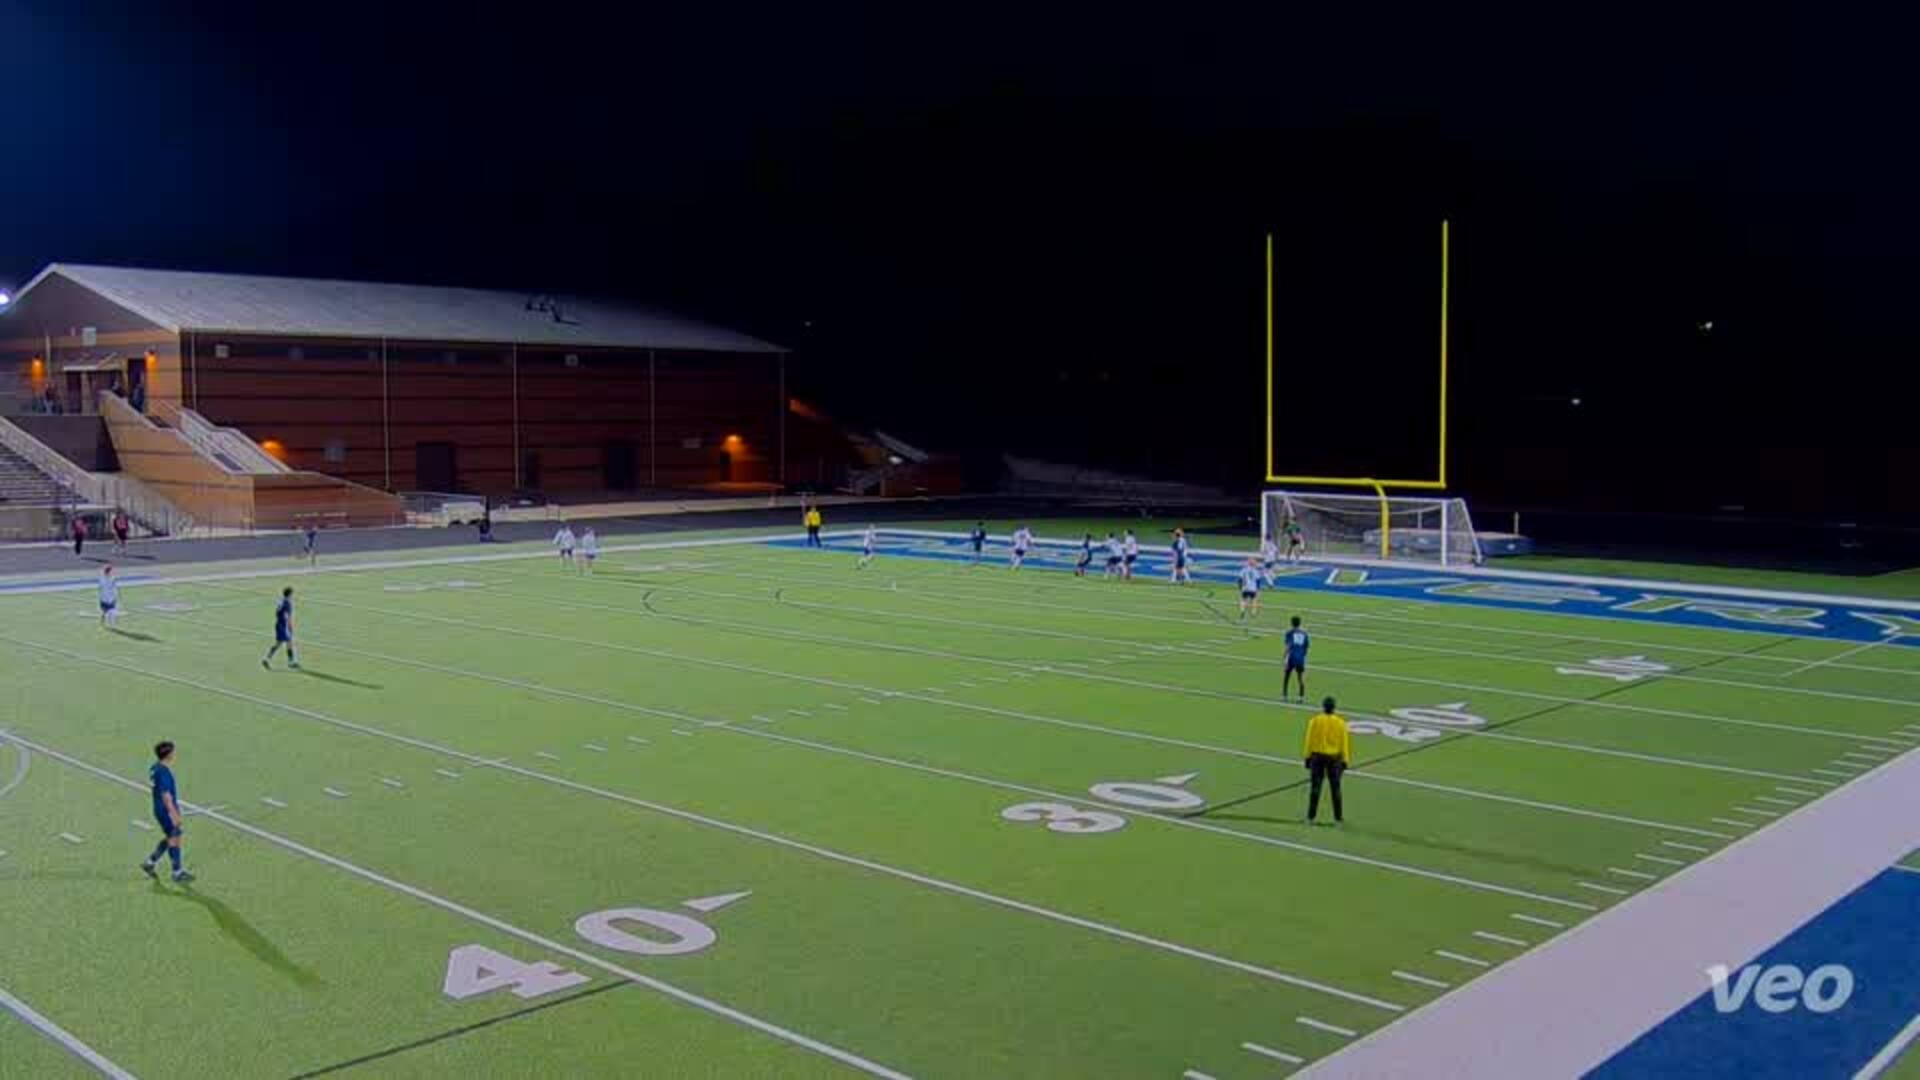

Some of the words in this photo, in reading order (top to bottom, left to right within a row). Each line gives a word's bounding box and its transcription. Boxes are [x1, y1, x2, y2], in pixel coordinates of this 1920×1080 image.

[1347, 707, 1486, 742] 20
[1001, 782, 1205, 832] 30
[442, 908, 717, 999] 40
